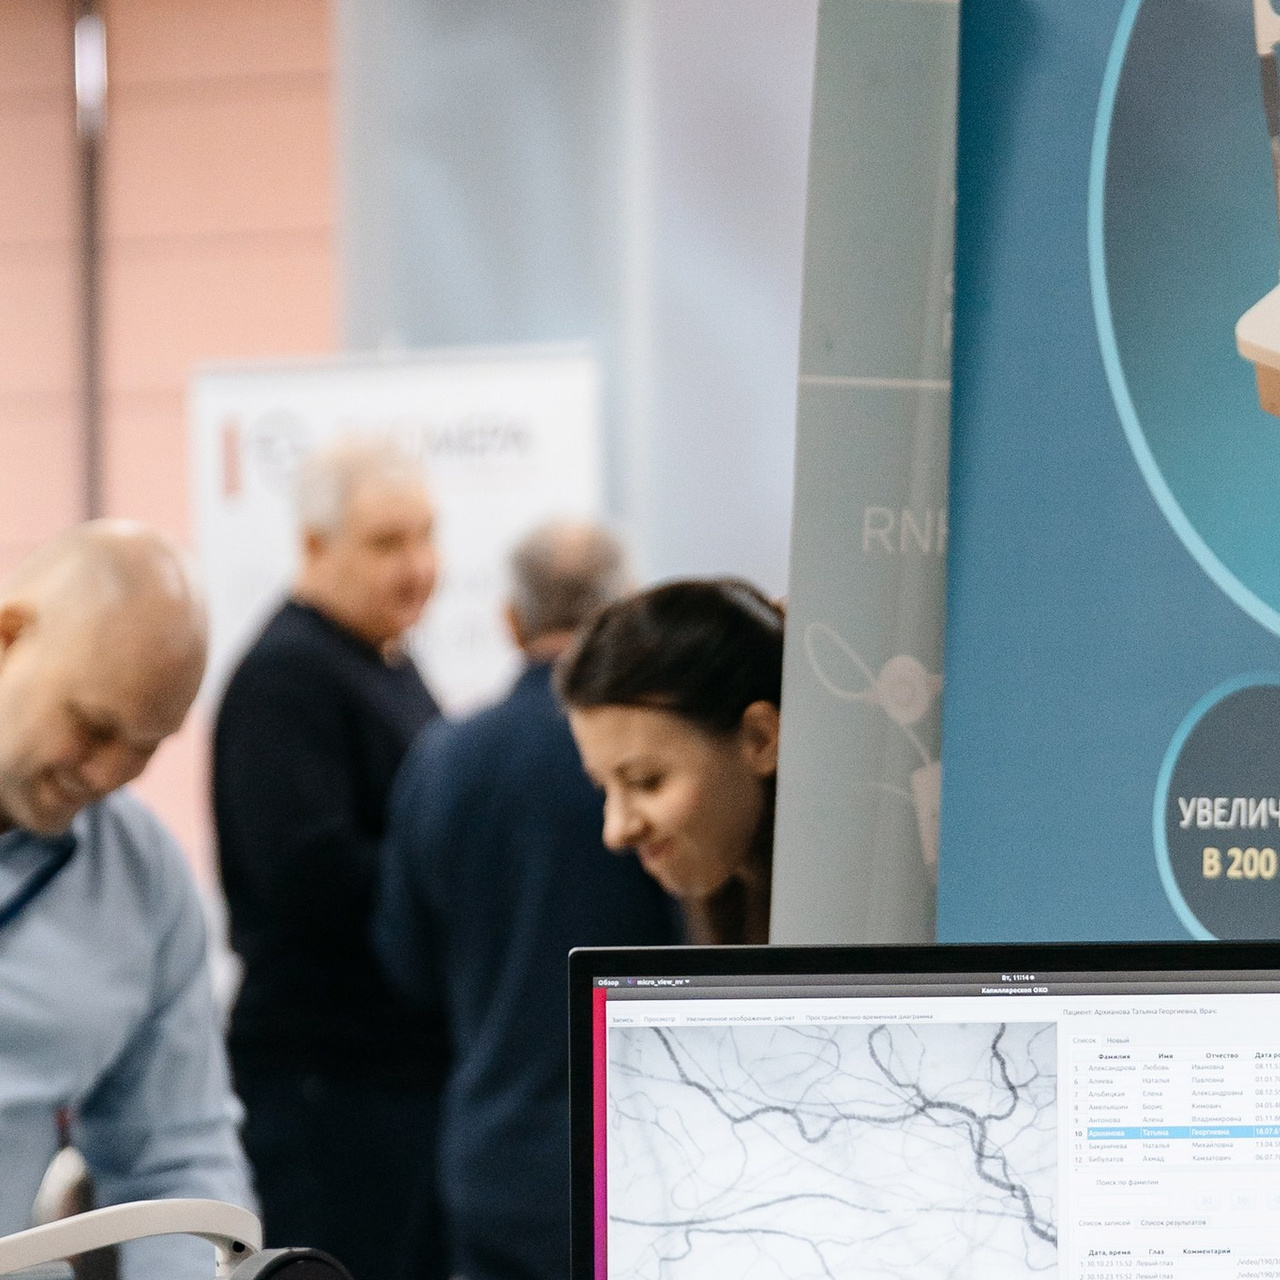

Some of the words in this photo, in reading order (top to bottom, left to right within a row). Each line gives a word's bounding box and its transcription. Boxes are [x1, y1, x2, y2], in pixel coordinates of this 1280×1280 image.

[1201, 847, 1221, 879] В
[1225, 846, 1275, 881] 200
[597, 979, 620, 987] Обзор
[981, 986, 1032, 995] Капилляроскоп
[1033, 986, 1049, 994] ОКО
[643, 1015, 676, 1024] Просмотр
[685, 1015, 728, 1023] Увеличенное
[899, 1013, 934, 1021] диаграмма
[1072, 1036, 1097, 1045] Список
[1106, 1035, 1130, 1045] Новый
[1078, 1219, 1102, 1227] Список
[1140, 1219, 1165, 1227] Список
[1166, 1219, 1207, 1228] результатов
[1109, 1249, 1131, 1257] время
[1182, 1247, 1231, 1255] Комментарий
